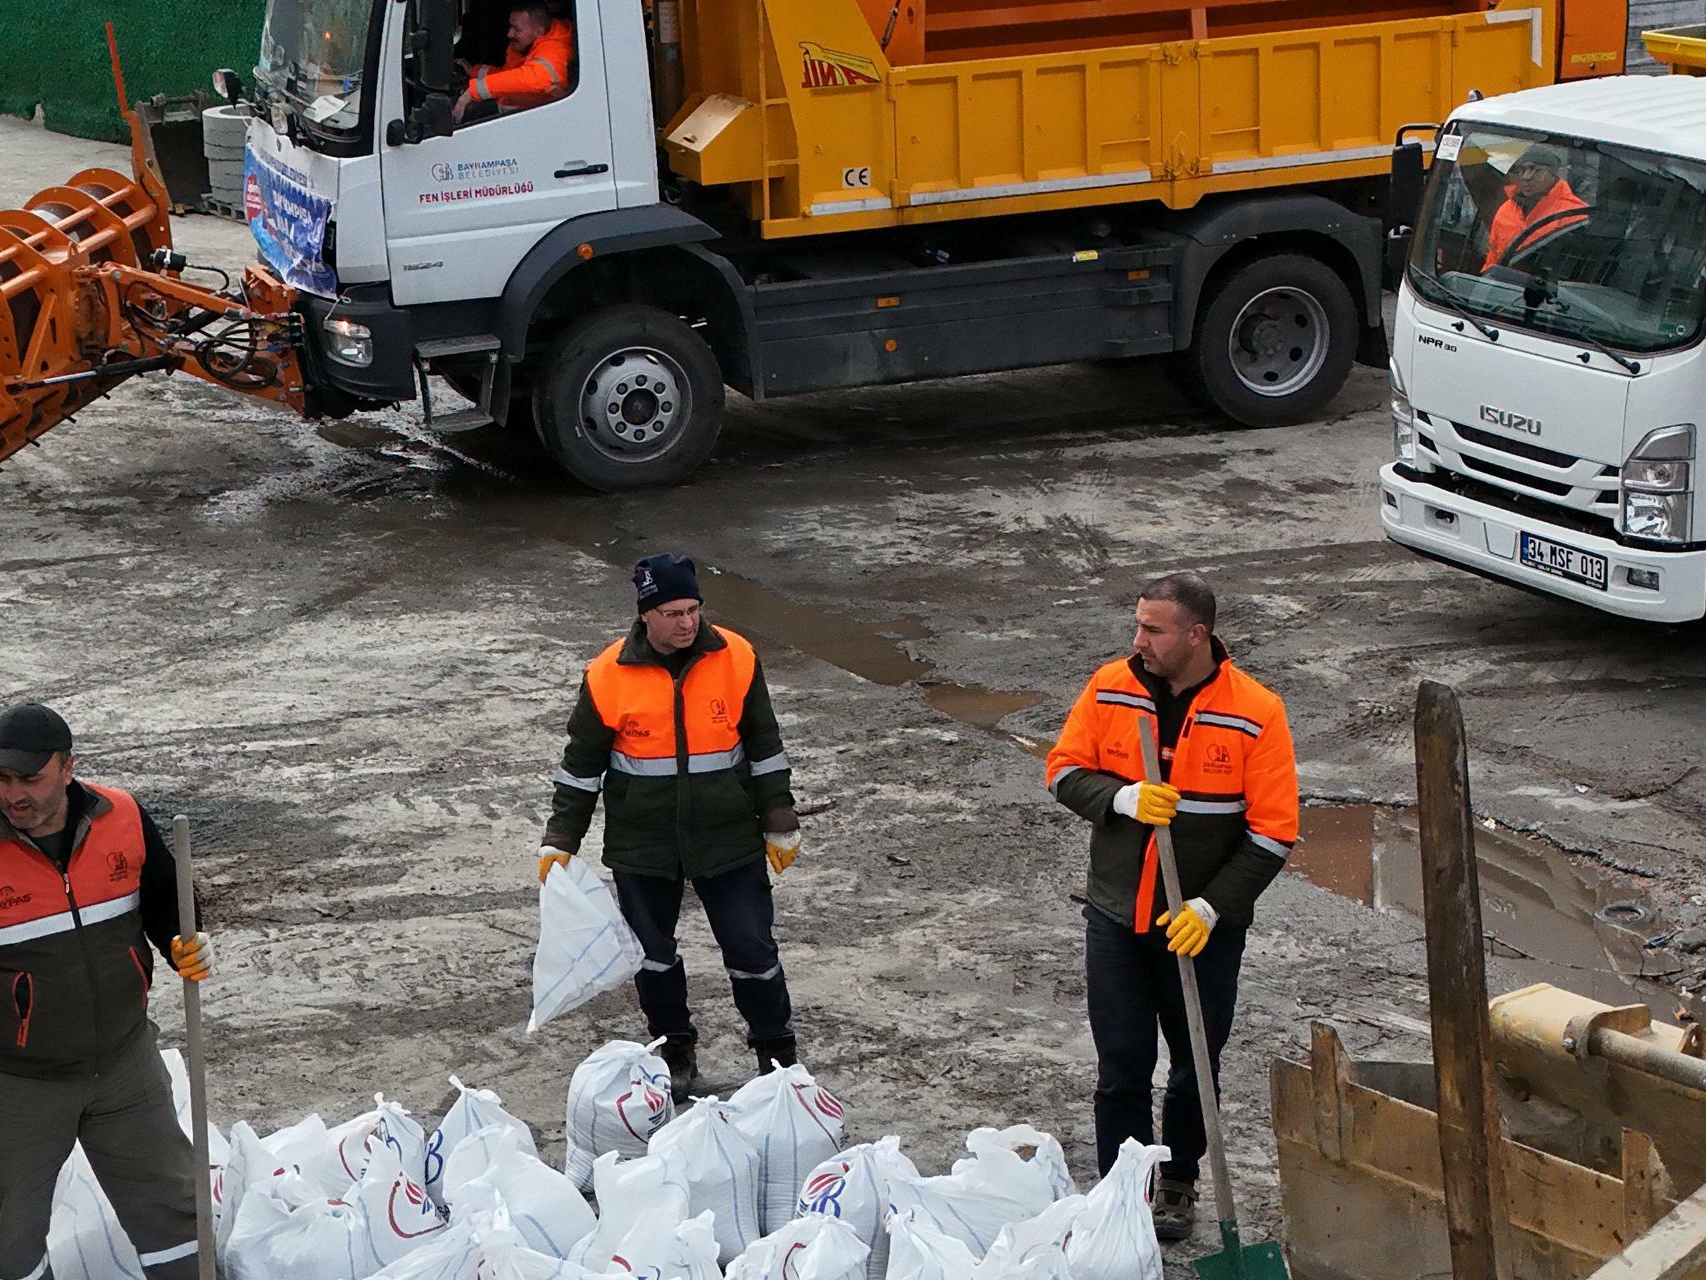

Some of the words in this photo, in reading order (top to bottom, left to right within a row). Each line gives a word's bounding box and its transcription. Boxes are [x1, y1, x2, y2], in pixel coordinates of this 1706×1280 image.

[457, 158, 517, 172] BAYRAMPAŞA
[419, 193, 438, 203] FEN
[441, 187, 472, 202] İŞLERİ
[475, 181, 533, 198] MÜDÜRLÜĞÜ
[1418, 334, 1443, 349] NPR
[1480, 404, 1541, 436] ISUZU
[1529, 539, 1544, 561] 34
[1549, 544, 1573, 570] MSF
[1580, 555, 1602, 580] 013
